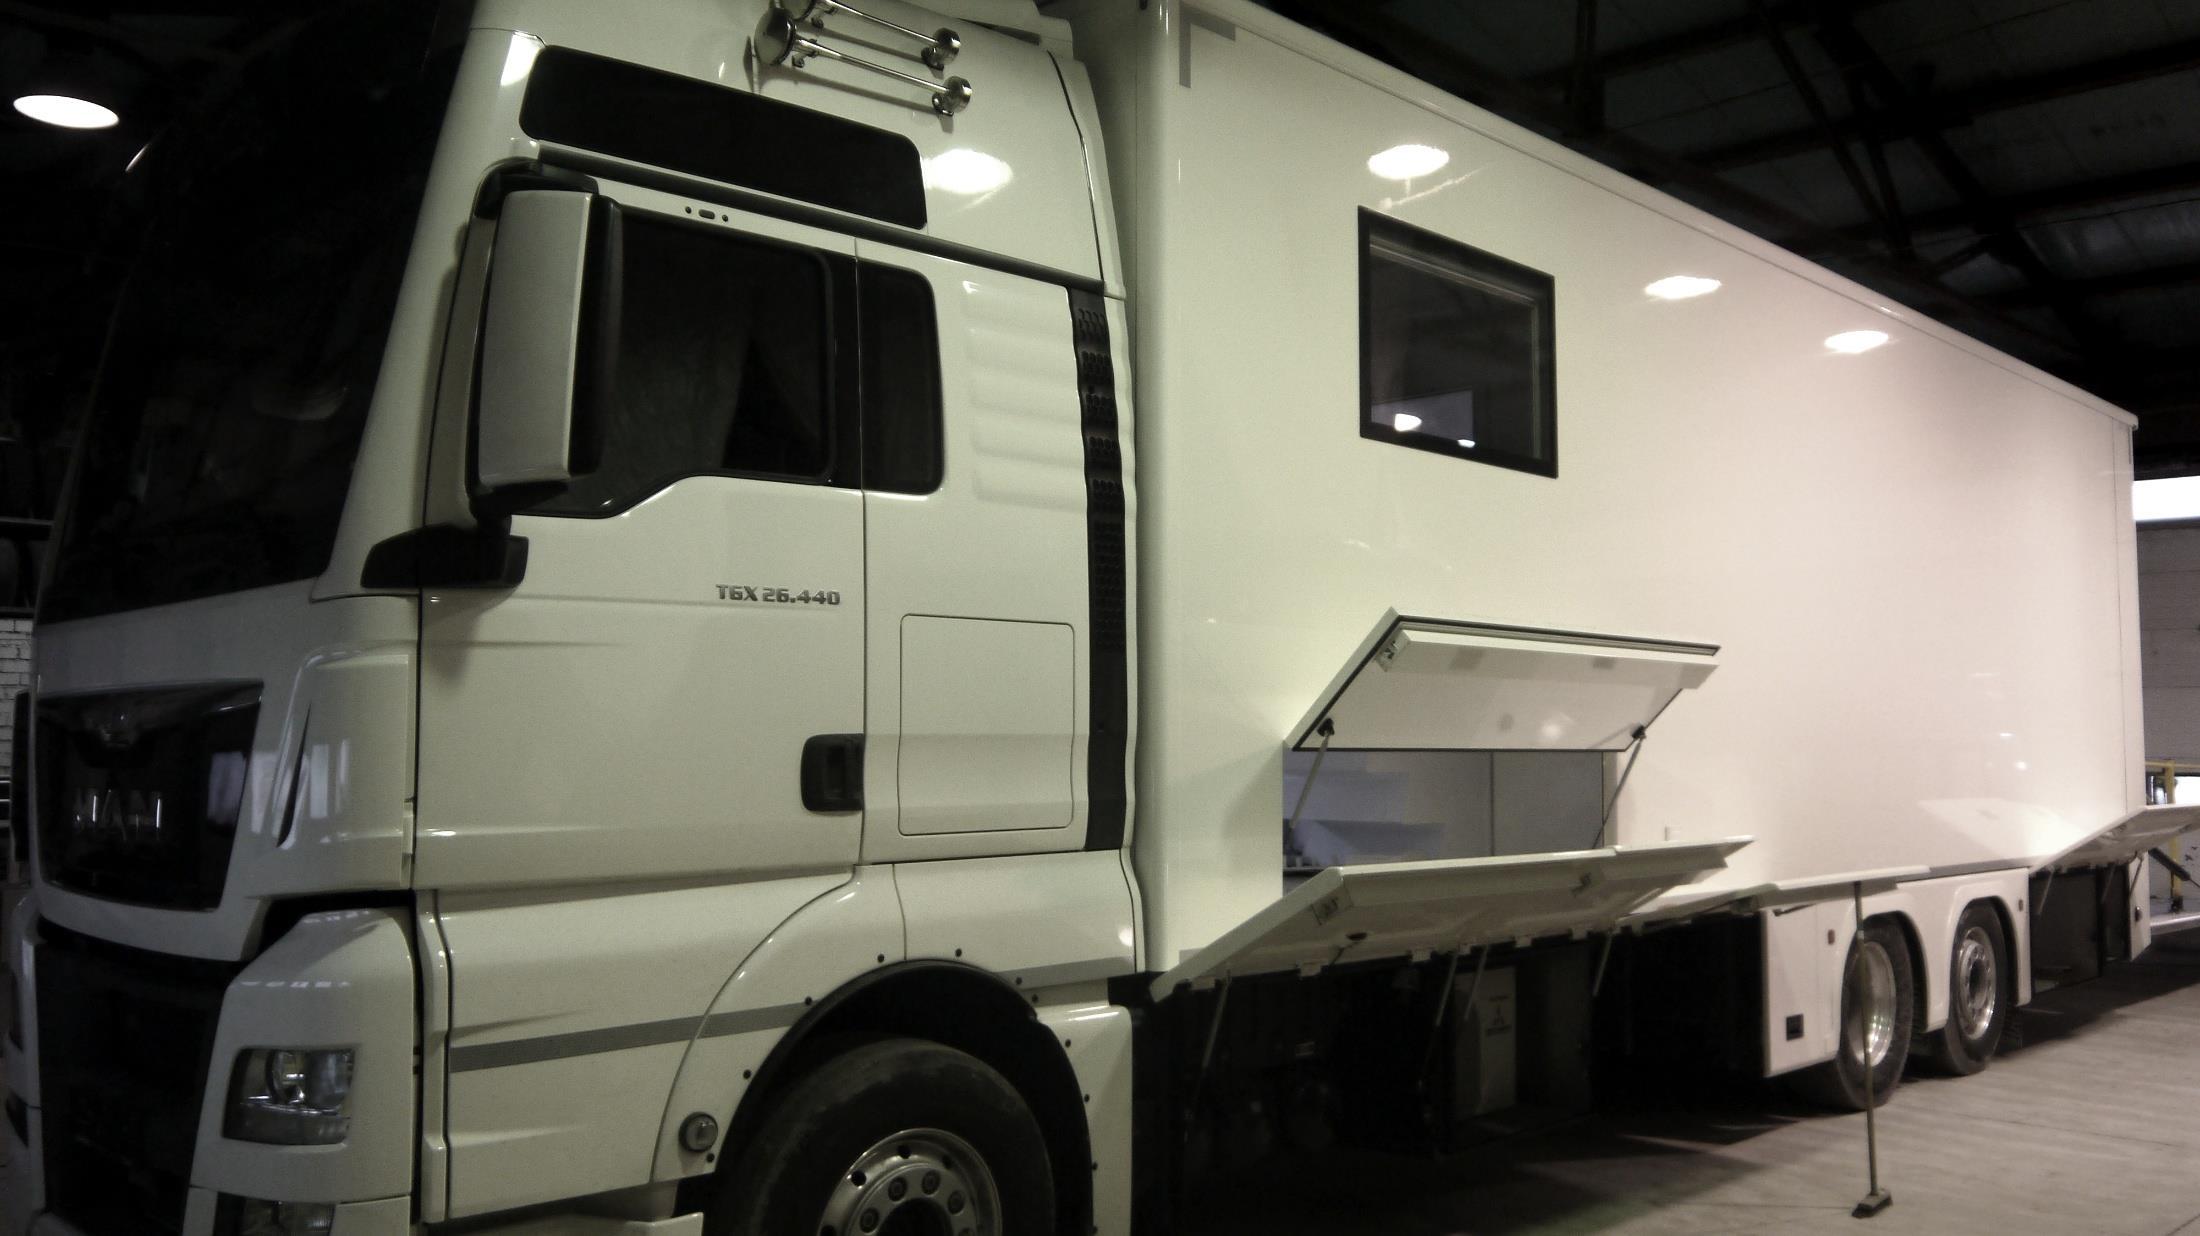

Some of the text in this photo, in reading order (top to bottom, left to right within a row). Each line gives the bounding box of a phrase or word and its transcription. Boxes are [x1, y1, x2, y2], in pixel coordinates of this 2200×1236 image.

[716, 584, 840, 605] TGX 26.440
[73, 788, 163, 841] MAN
